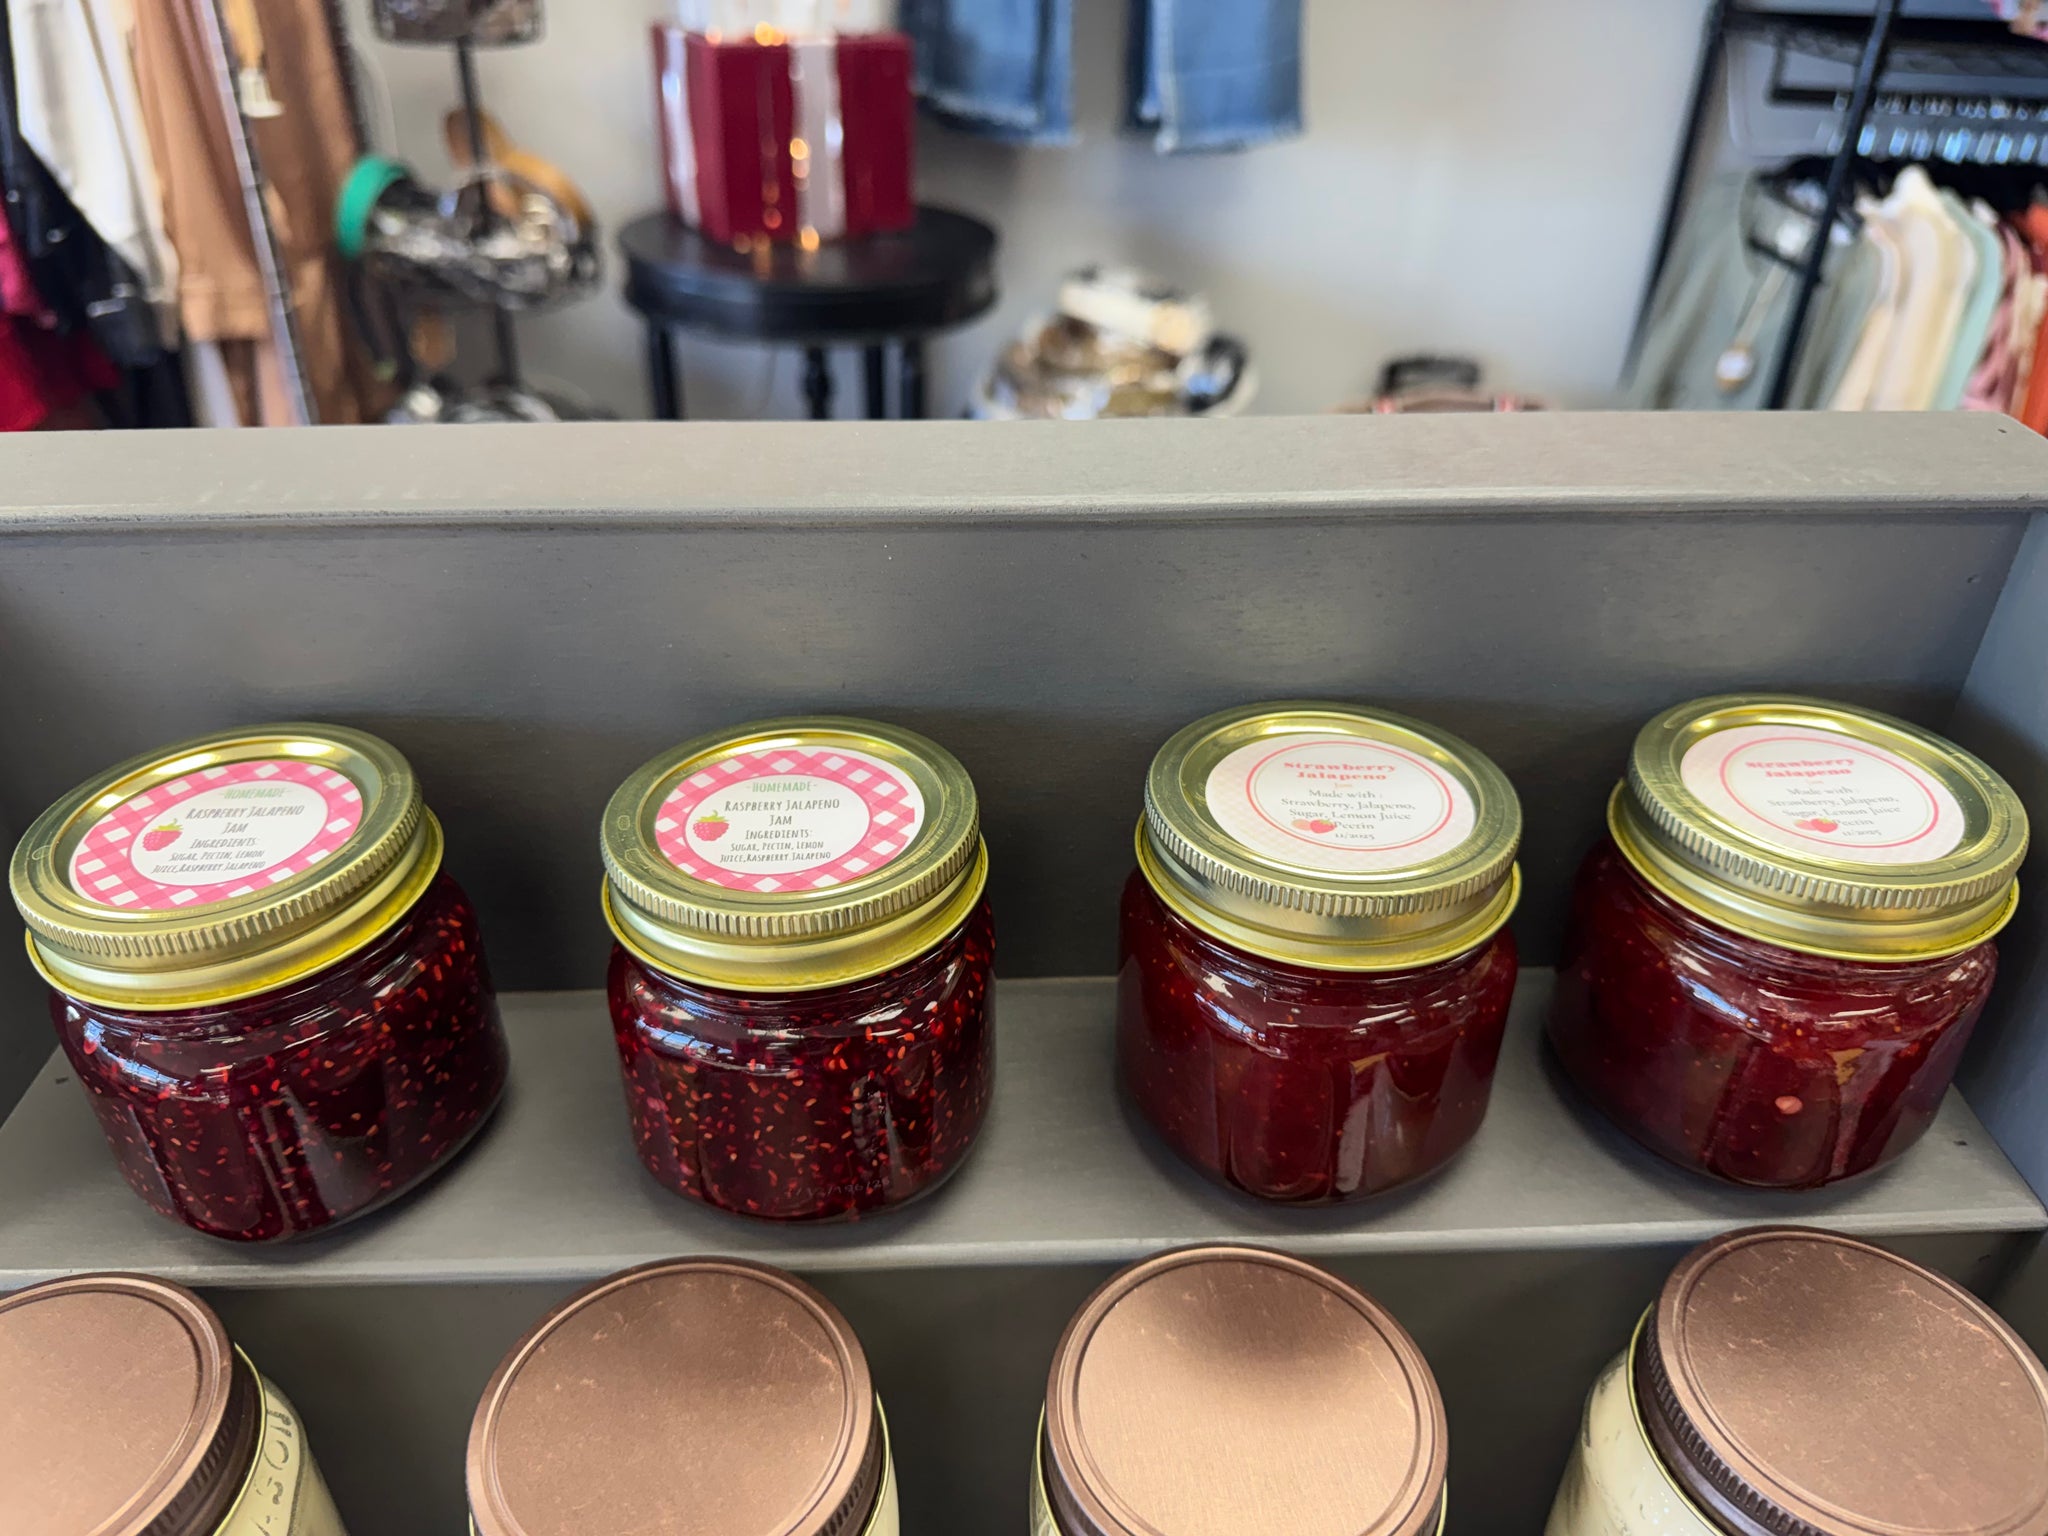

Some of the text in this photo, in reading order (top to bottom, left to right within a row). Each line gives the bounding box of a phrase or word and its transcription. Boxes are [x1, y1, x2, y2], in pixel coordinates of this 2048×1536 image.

[1309, 789, 1343, 798] Made
[769, 815, 792, 825] JAM
[223, 823, 248, 834] JAM
